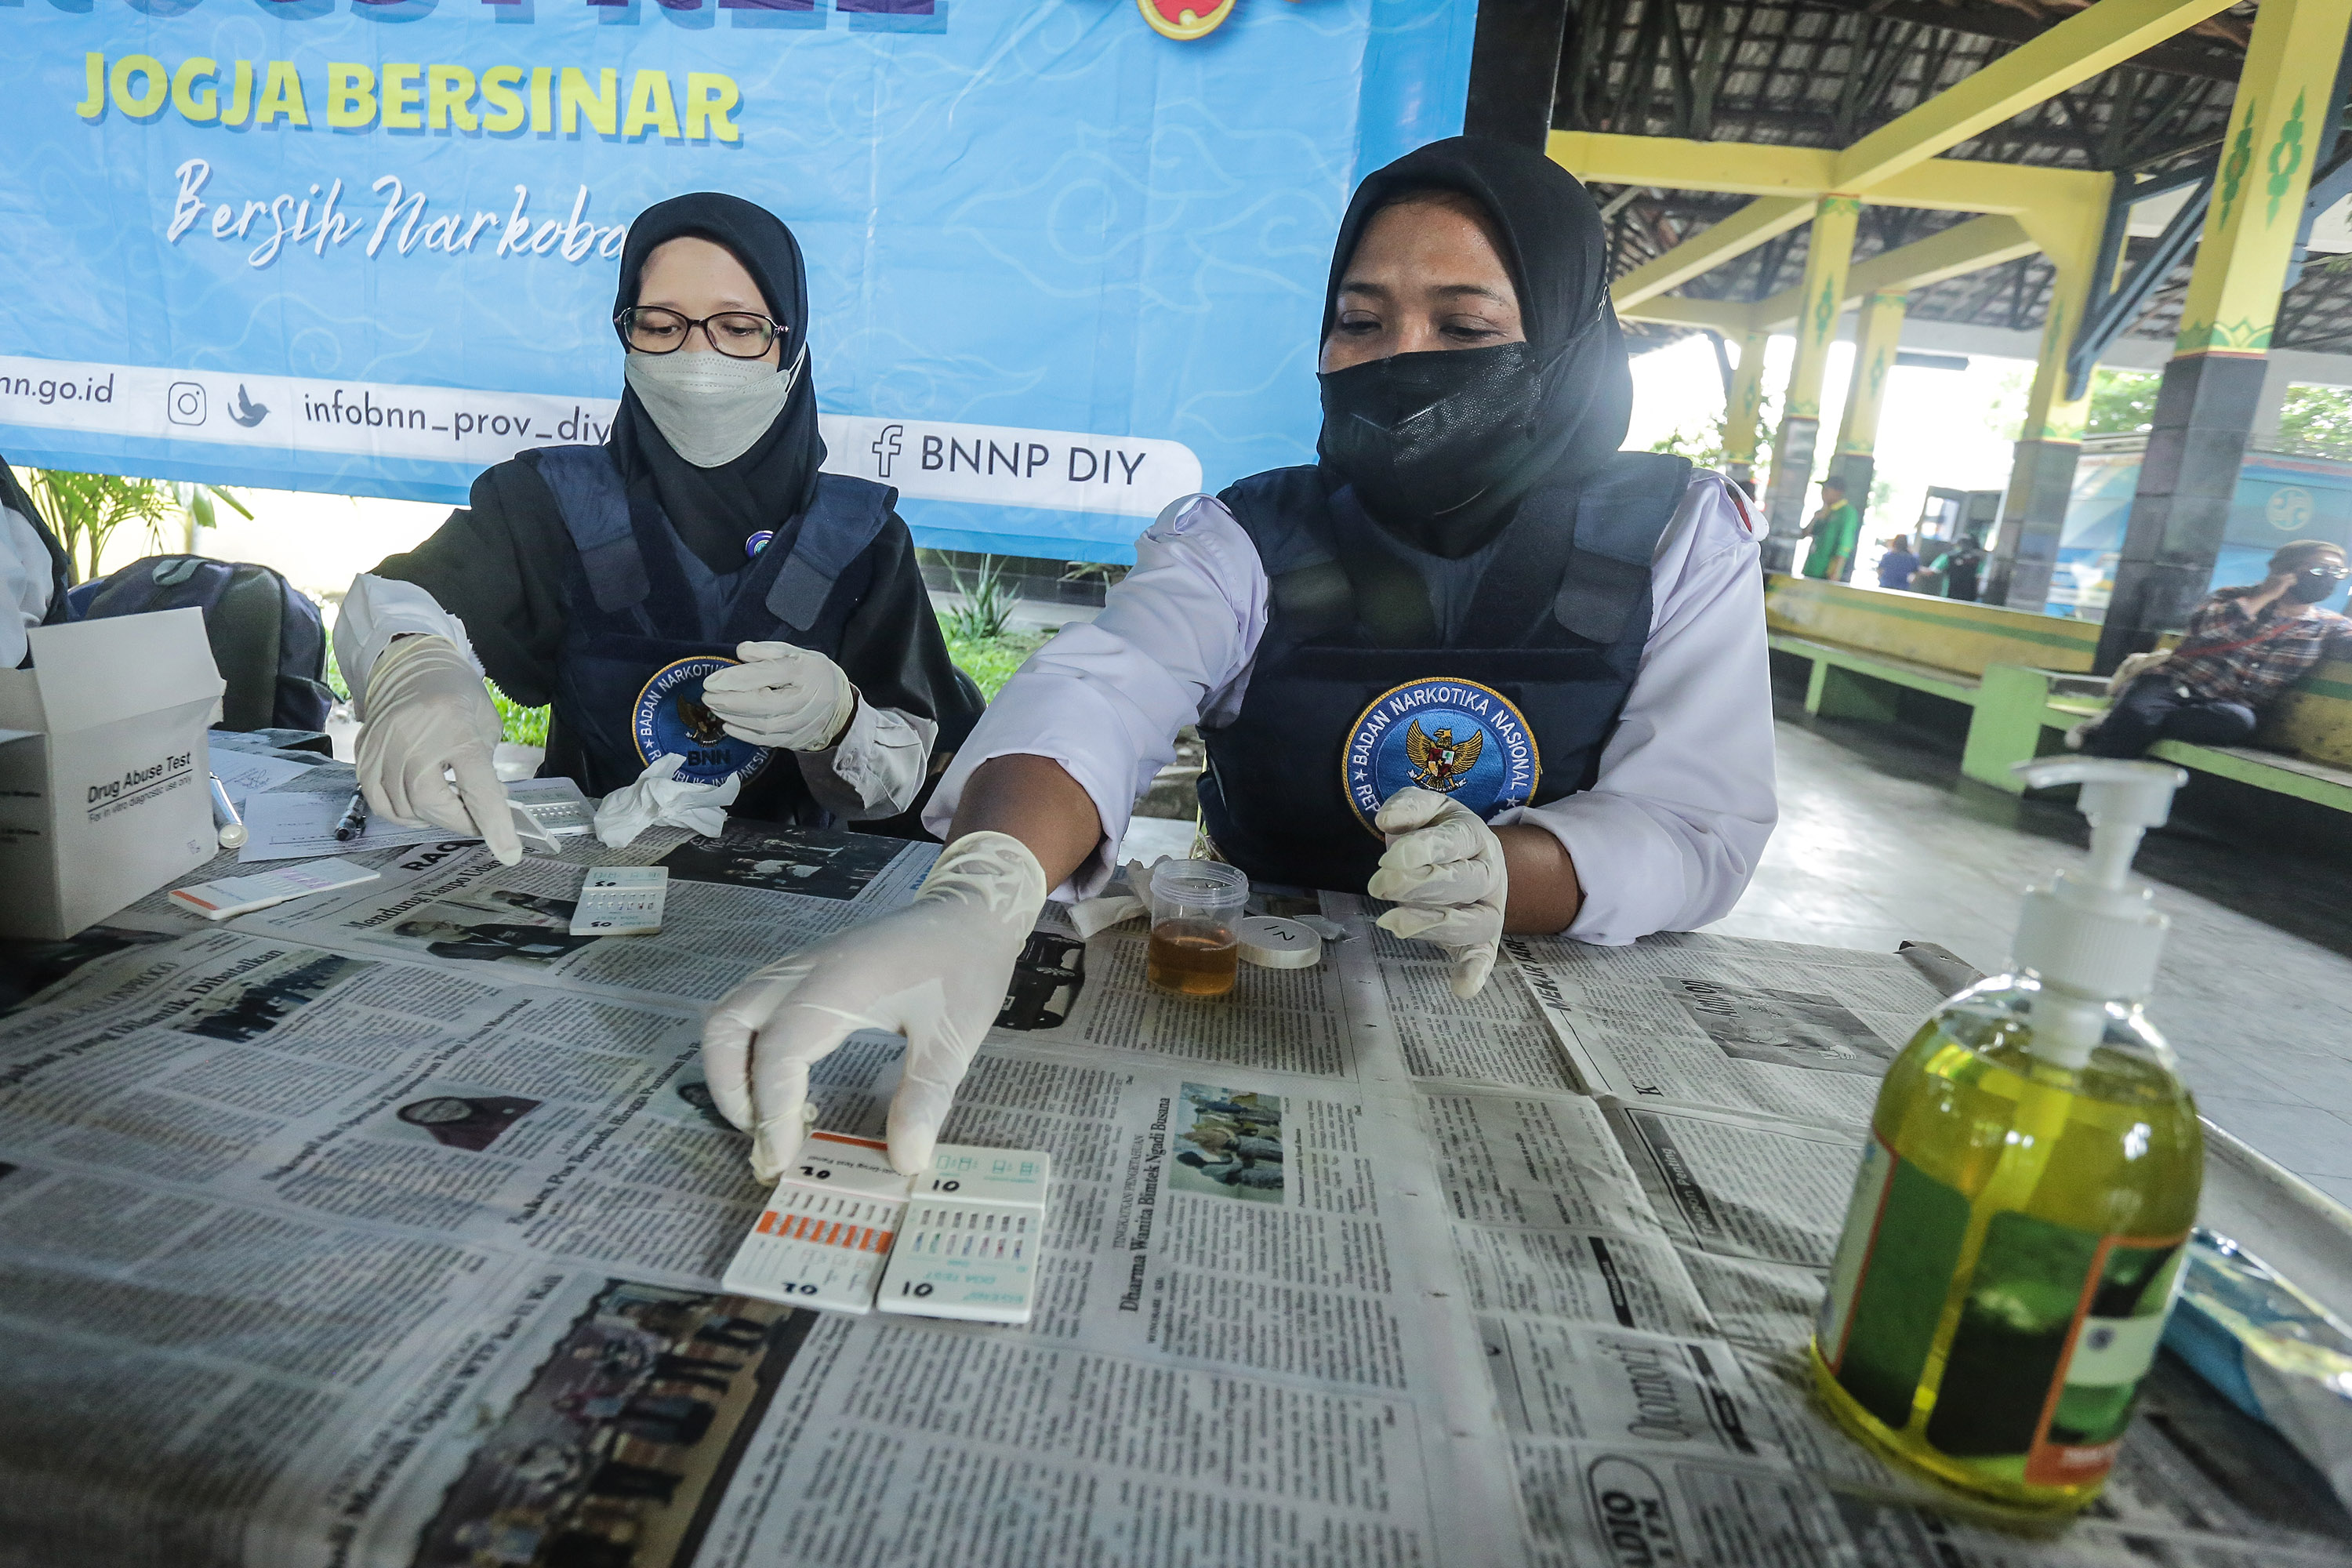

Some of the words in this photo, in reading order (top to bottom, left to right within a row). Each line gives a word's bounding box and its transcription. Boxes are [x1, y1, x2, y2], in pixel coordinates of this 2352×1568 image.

[76, 52, 310, 130] JOGJA
[327, 62, 741, 147] BERSINAR
[166, 158, 362, 267] Bersih
[921, 434, 1049, 478] BNNP
[1068, 446, 1146, 485] DIY
[641, 690, 662, 736] BADAN
[688, 749, 731, 766] BNN
[1353, 710, 1391, 766] BADAN
[1389, 687, 1489, 716] NARKOTIKA
[1490, 710, 1530, 790] NASIONAL
[88, 779, 121, 804] Drug
[123, 763, 163, 789] Abuse
[166, 751, 191, 771] Test
[186, 949, 285, 995] Dibatalkan
[1505, 940, 1538, 965] SARI
[1522, 964, 1572, 1012] MEKAR
[1150, 1098, 1171, 1137] Busana
[1145, 1134, 1167, 1171] Ngadi
[1138, 1166, 1160, 1213] Bimtek
[1129, 1210, 1152, 1252] Wanita
[1119, 1254, 1147, 1314] Dharma
